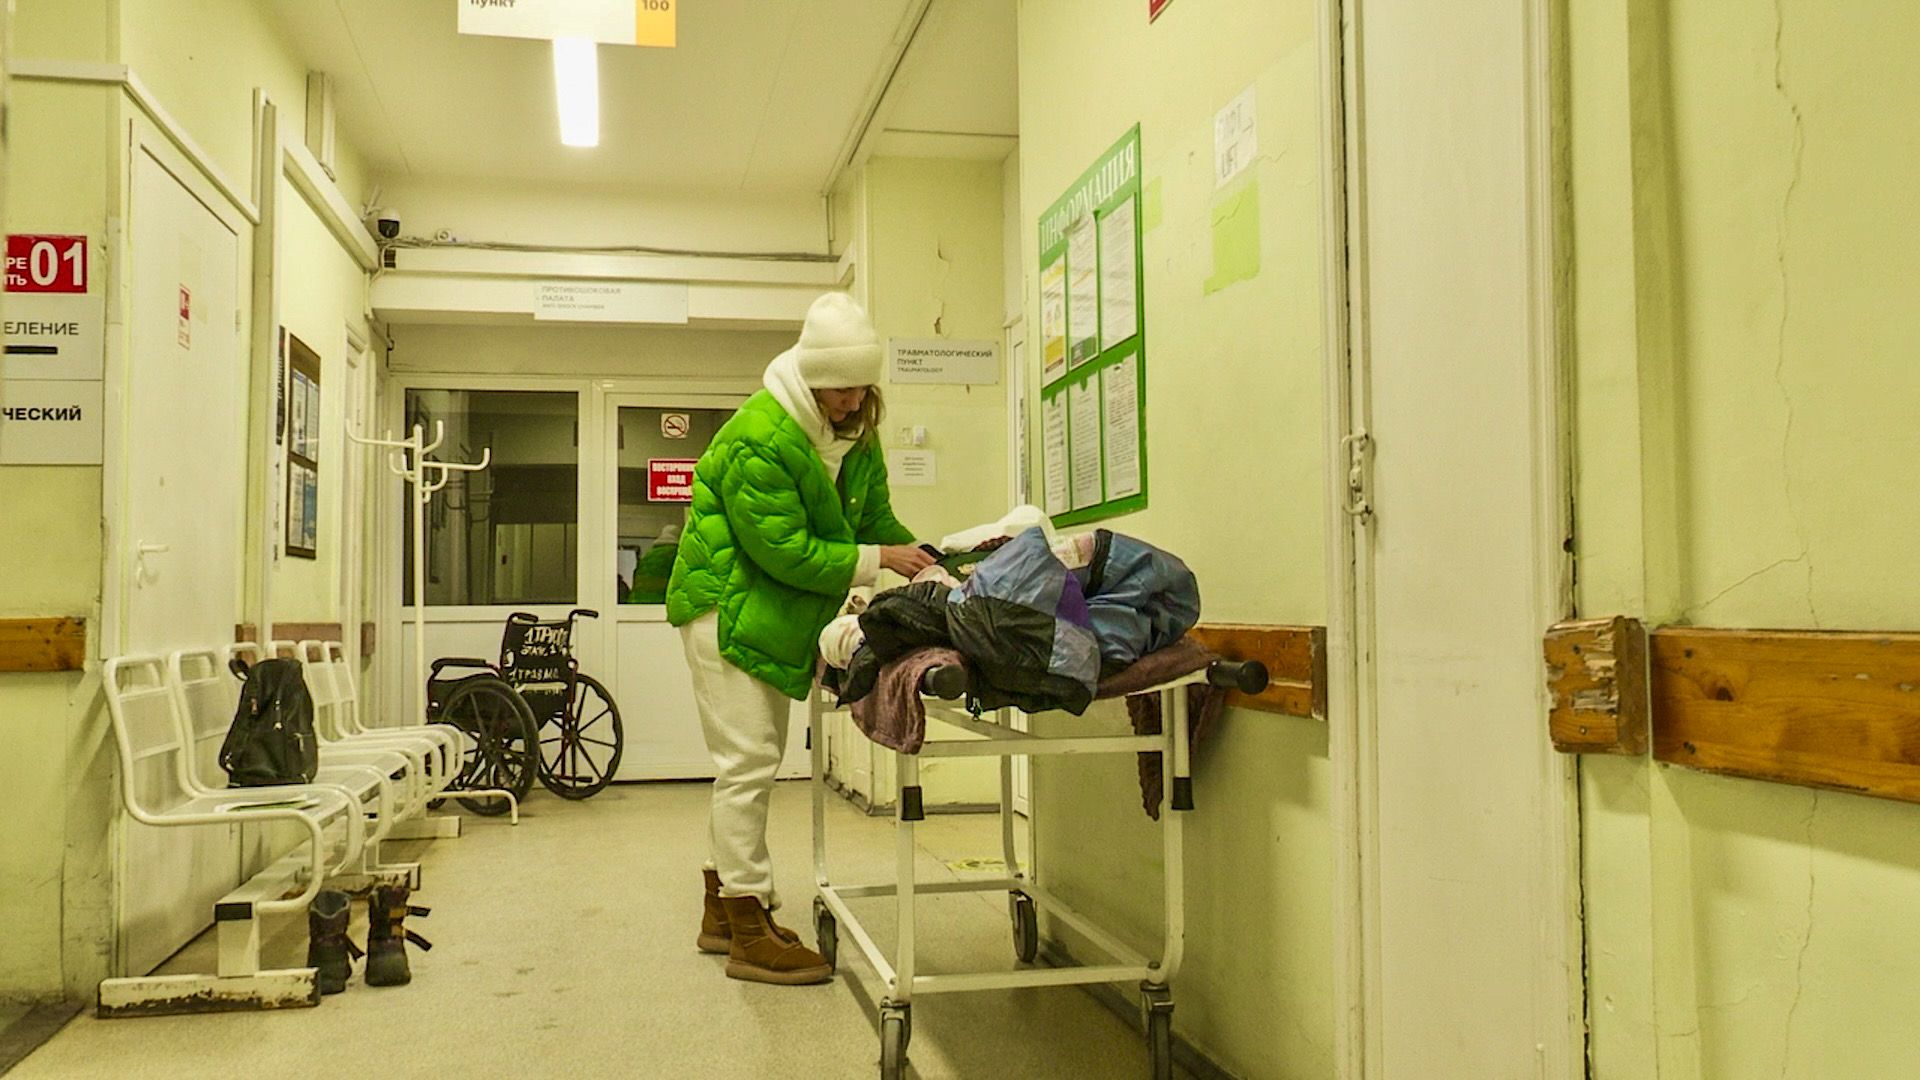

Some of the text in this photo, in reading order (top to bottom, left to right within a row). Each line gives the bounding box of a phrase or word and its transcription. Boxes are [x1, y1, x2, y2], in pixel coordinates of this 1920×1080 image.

[643, 0, 670, 11] 100
[30, 241, 83, 286] 01
[4, 322, 79, 335] ЕЛЕНИЕ
[897, 349, 993, 358] ТРАВМАТОЛОГИЧЕСКИЙ
[897, 358, 922, 366] ПУНКТ
